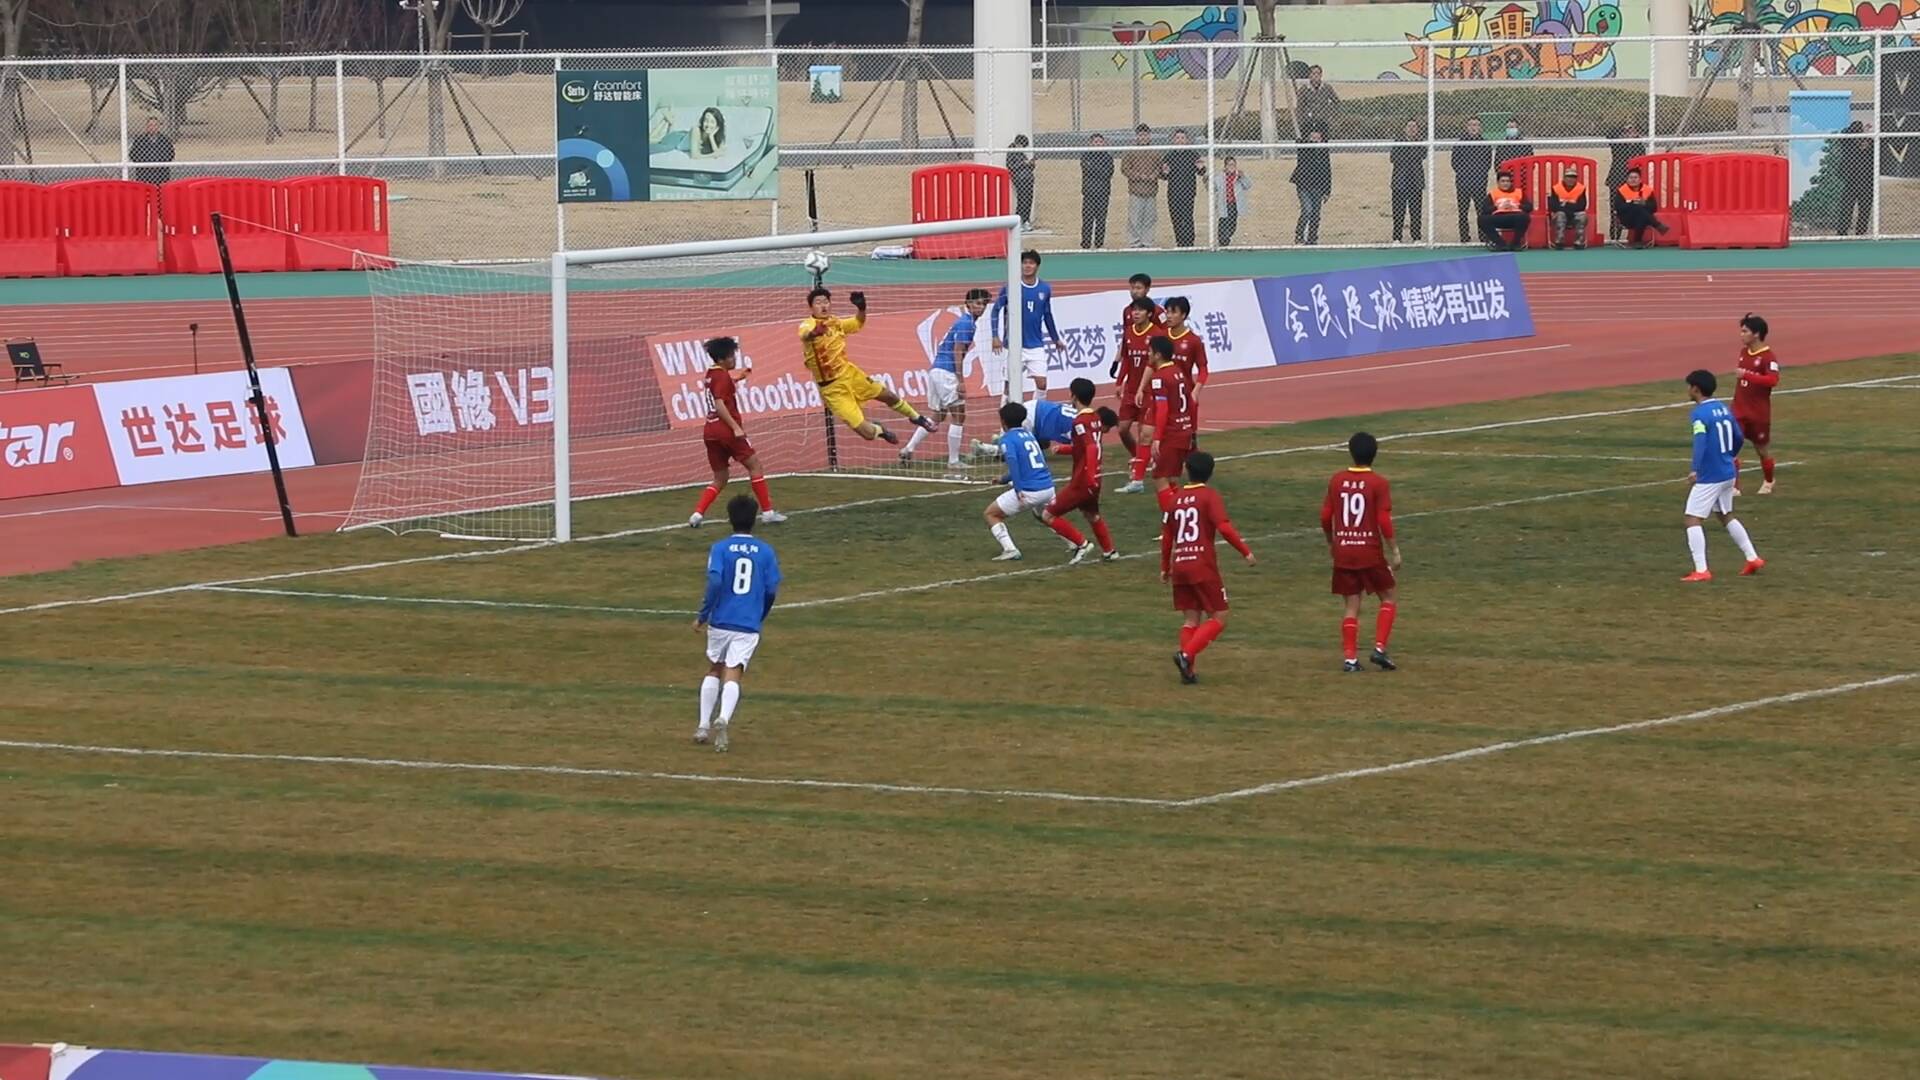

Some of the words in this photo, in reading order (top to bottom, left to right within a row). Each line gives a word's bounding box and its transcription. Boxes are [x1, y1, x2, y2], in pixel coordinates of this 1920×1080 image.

[1027, 301, 1034, 312] 4
[1178, 383, 1187, 413] 5
[121, 395, 287, 457] 世达足球
[1715, 419, 1734, 453] 11
[1174, 506, 1200, 544] 23
[1340, 492, 1366, 528] 19
[732, 557, 753, 595] 8
